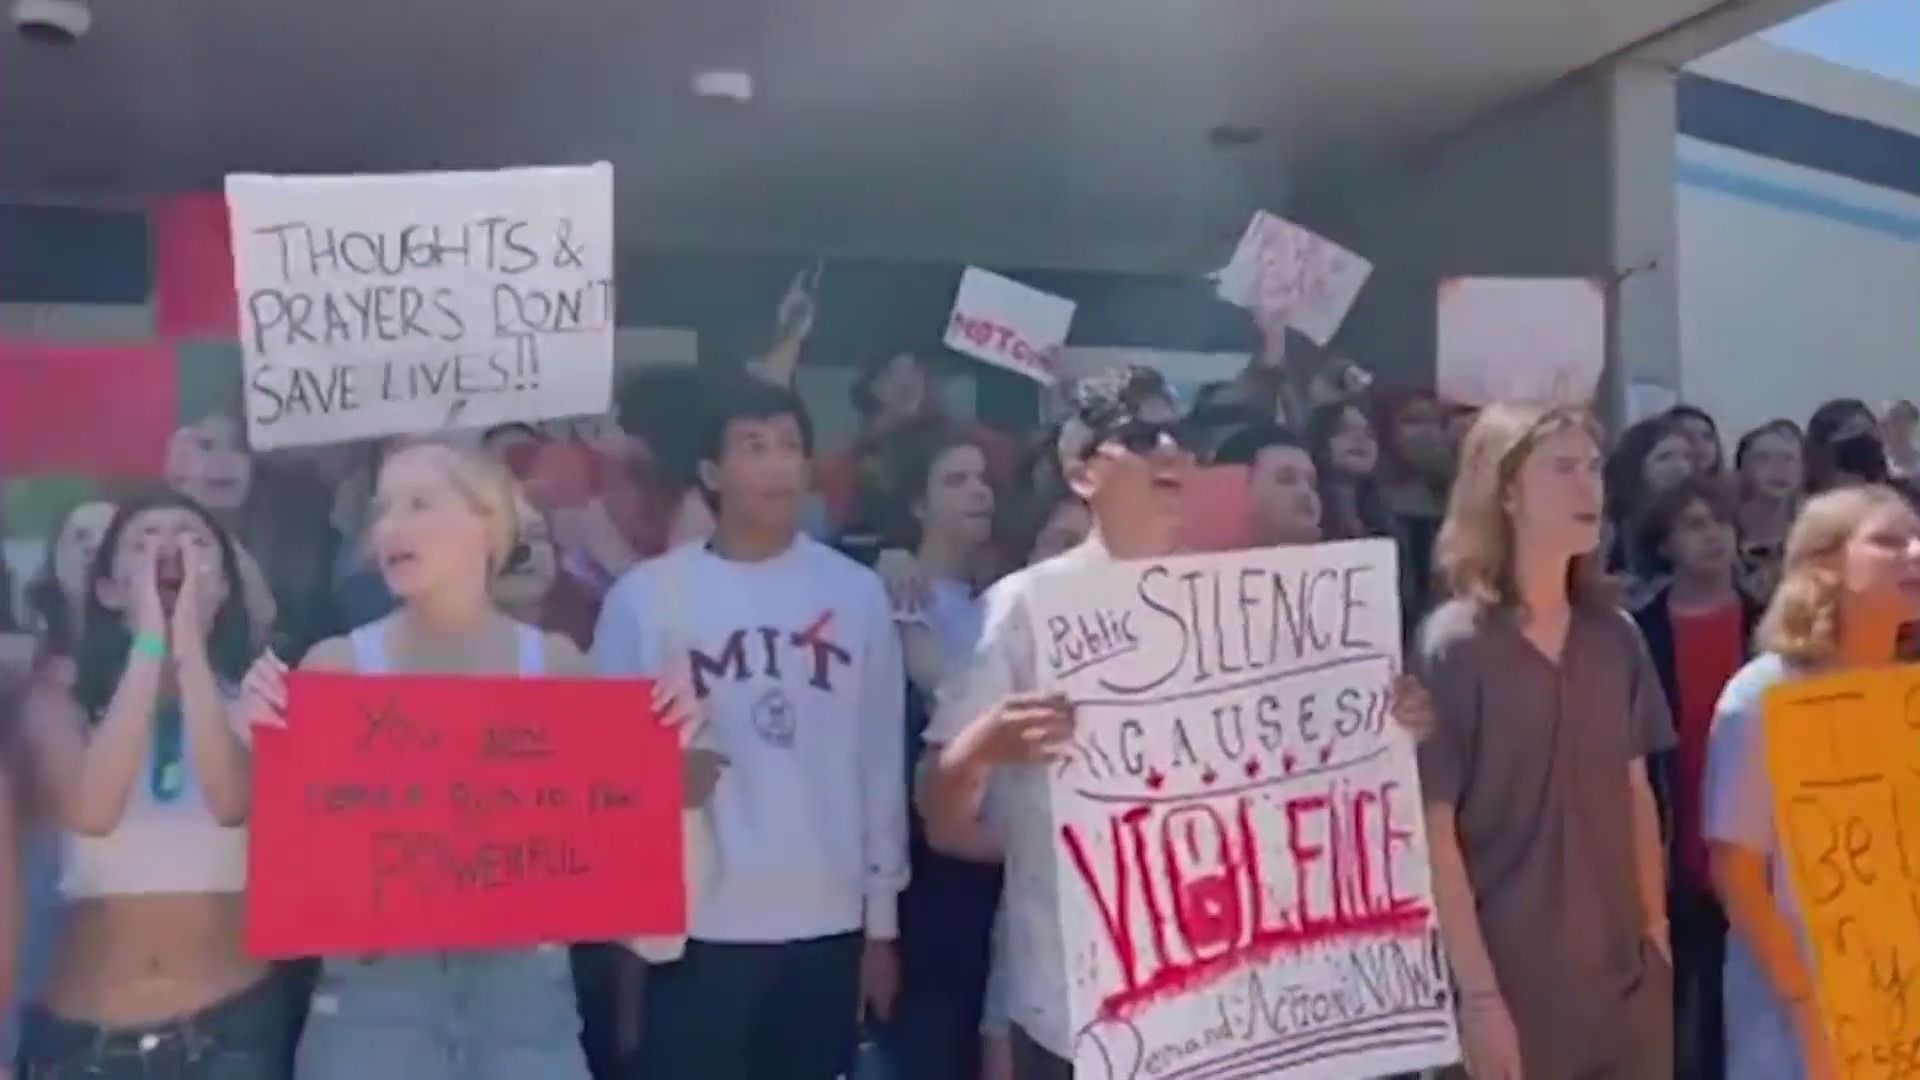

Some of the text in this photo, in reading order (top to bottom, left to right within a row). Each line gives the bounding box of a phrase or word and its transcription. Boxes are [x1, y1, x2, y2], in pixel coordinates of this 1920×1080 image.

[254, 216, 587, 281] THOUGHTS &
[247, 278, 613, 354] PRAYERS DON'T
[251, 333, 541, 426] SAVE LIVES!!
[688, 608, 852, 698] MIT
[1047, 564, 1375, 694] Public SILENCE
[1062, 781, 1426, 995] VIOLENCE
